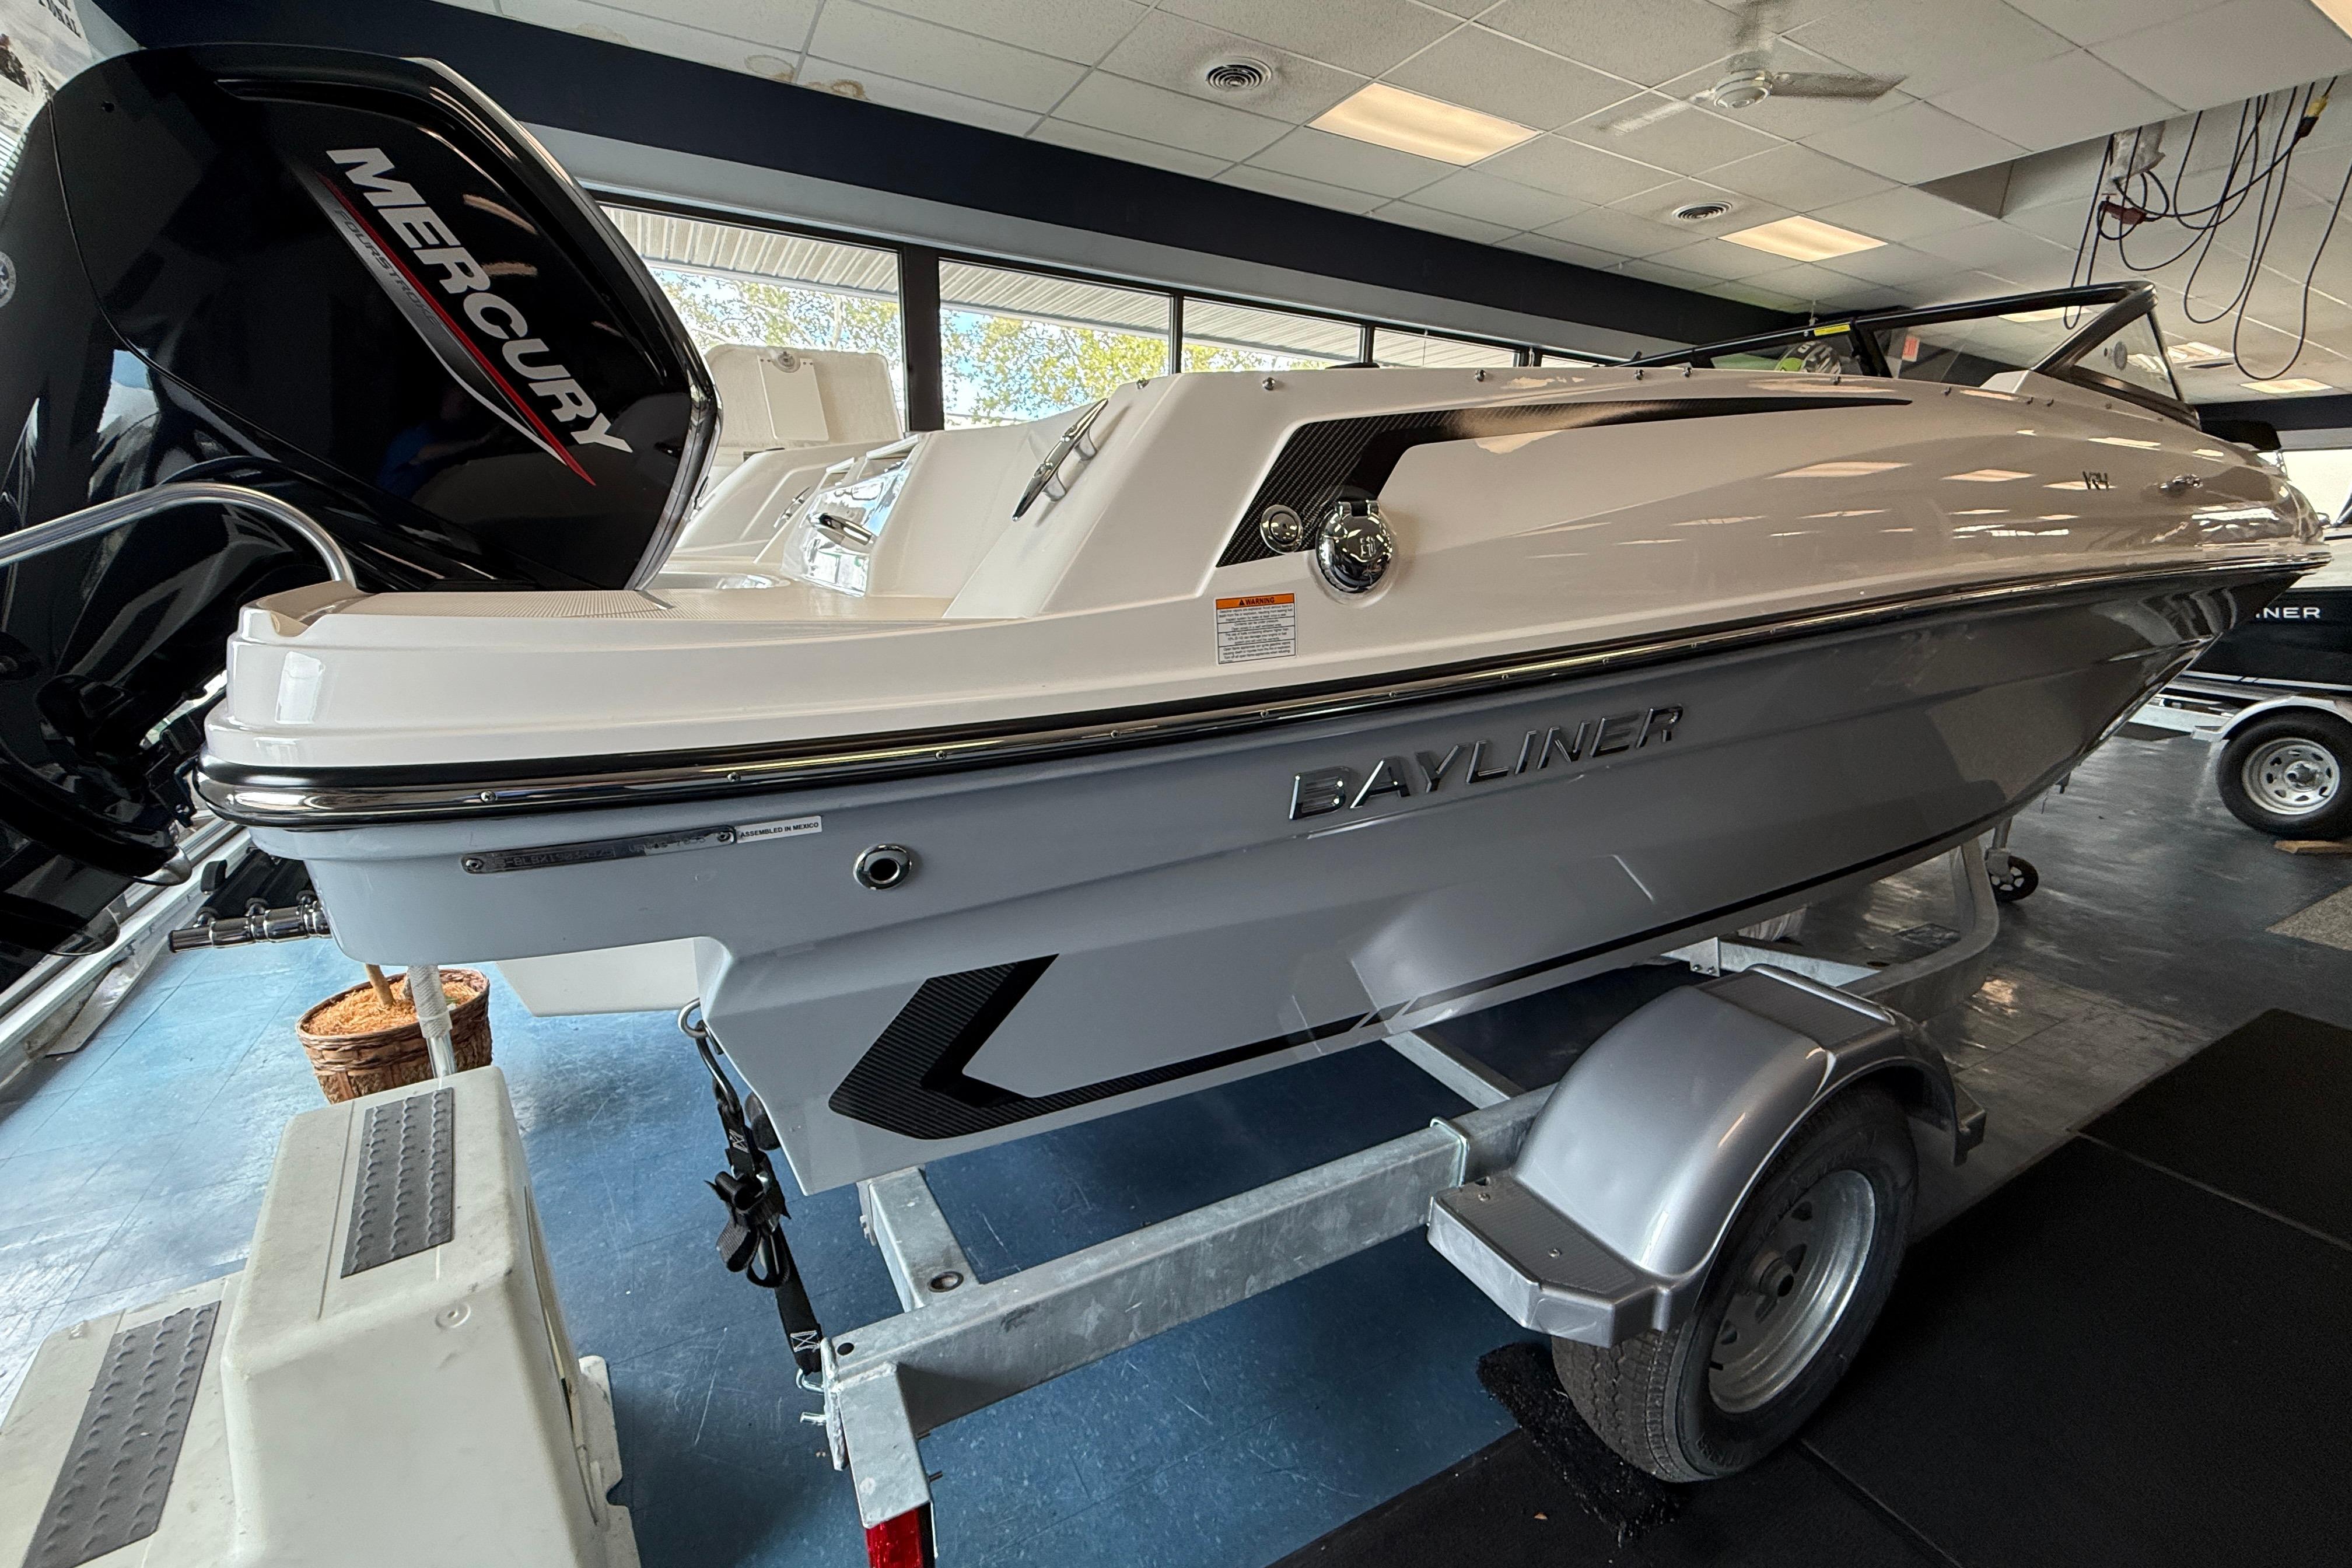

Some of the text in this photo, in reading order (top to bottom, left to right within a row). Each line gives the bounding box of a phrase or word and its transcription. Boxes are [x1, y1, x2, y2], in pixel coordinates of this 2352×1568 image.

[326, 148, 633, 453] MERCURY
[333, 208, 438, 327] FOURSTROKE
[1245, 596, 1275, 606] WARNING
[1288, 704, 1684, 820] BAYLINER
[740, 828, 783, 838] ASSEMBLED
